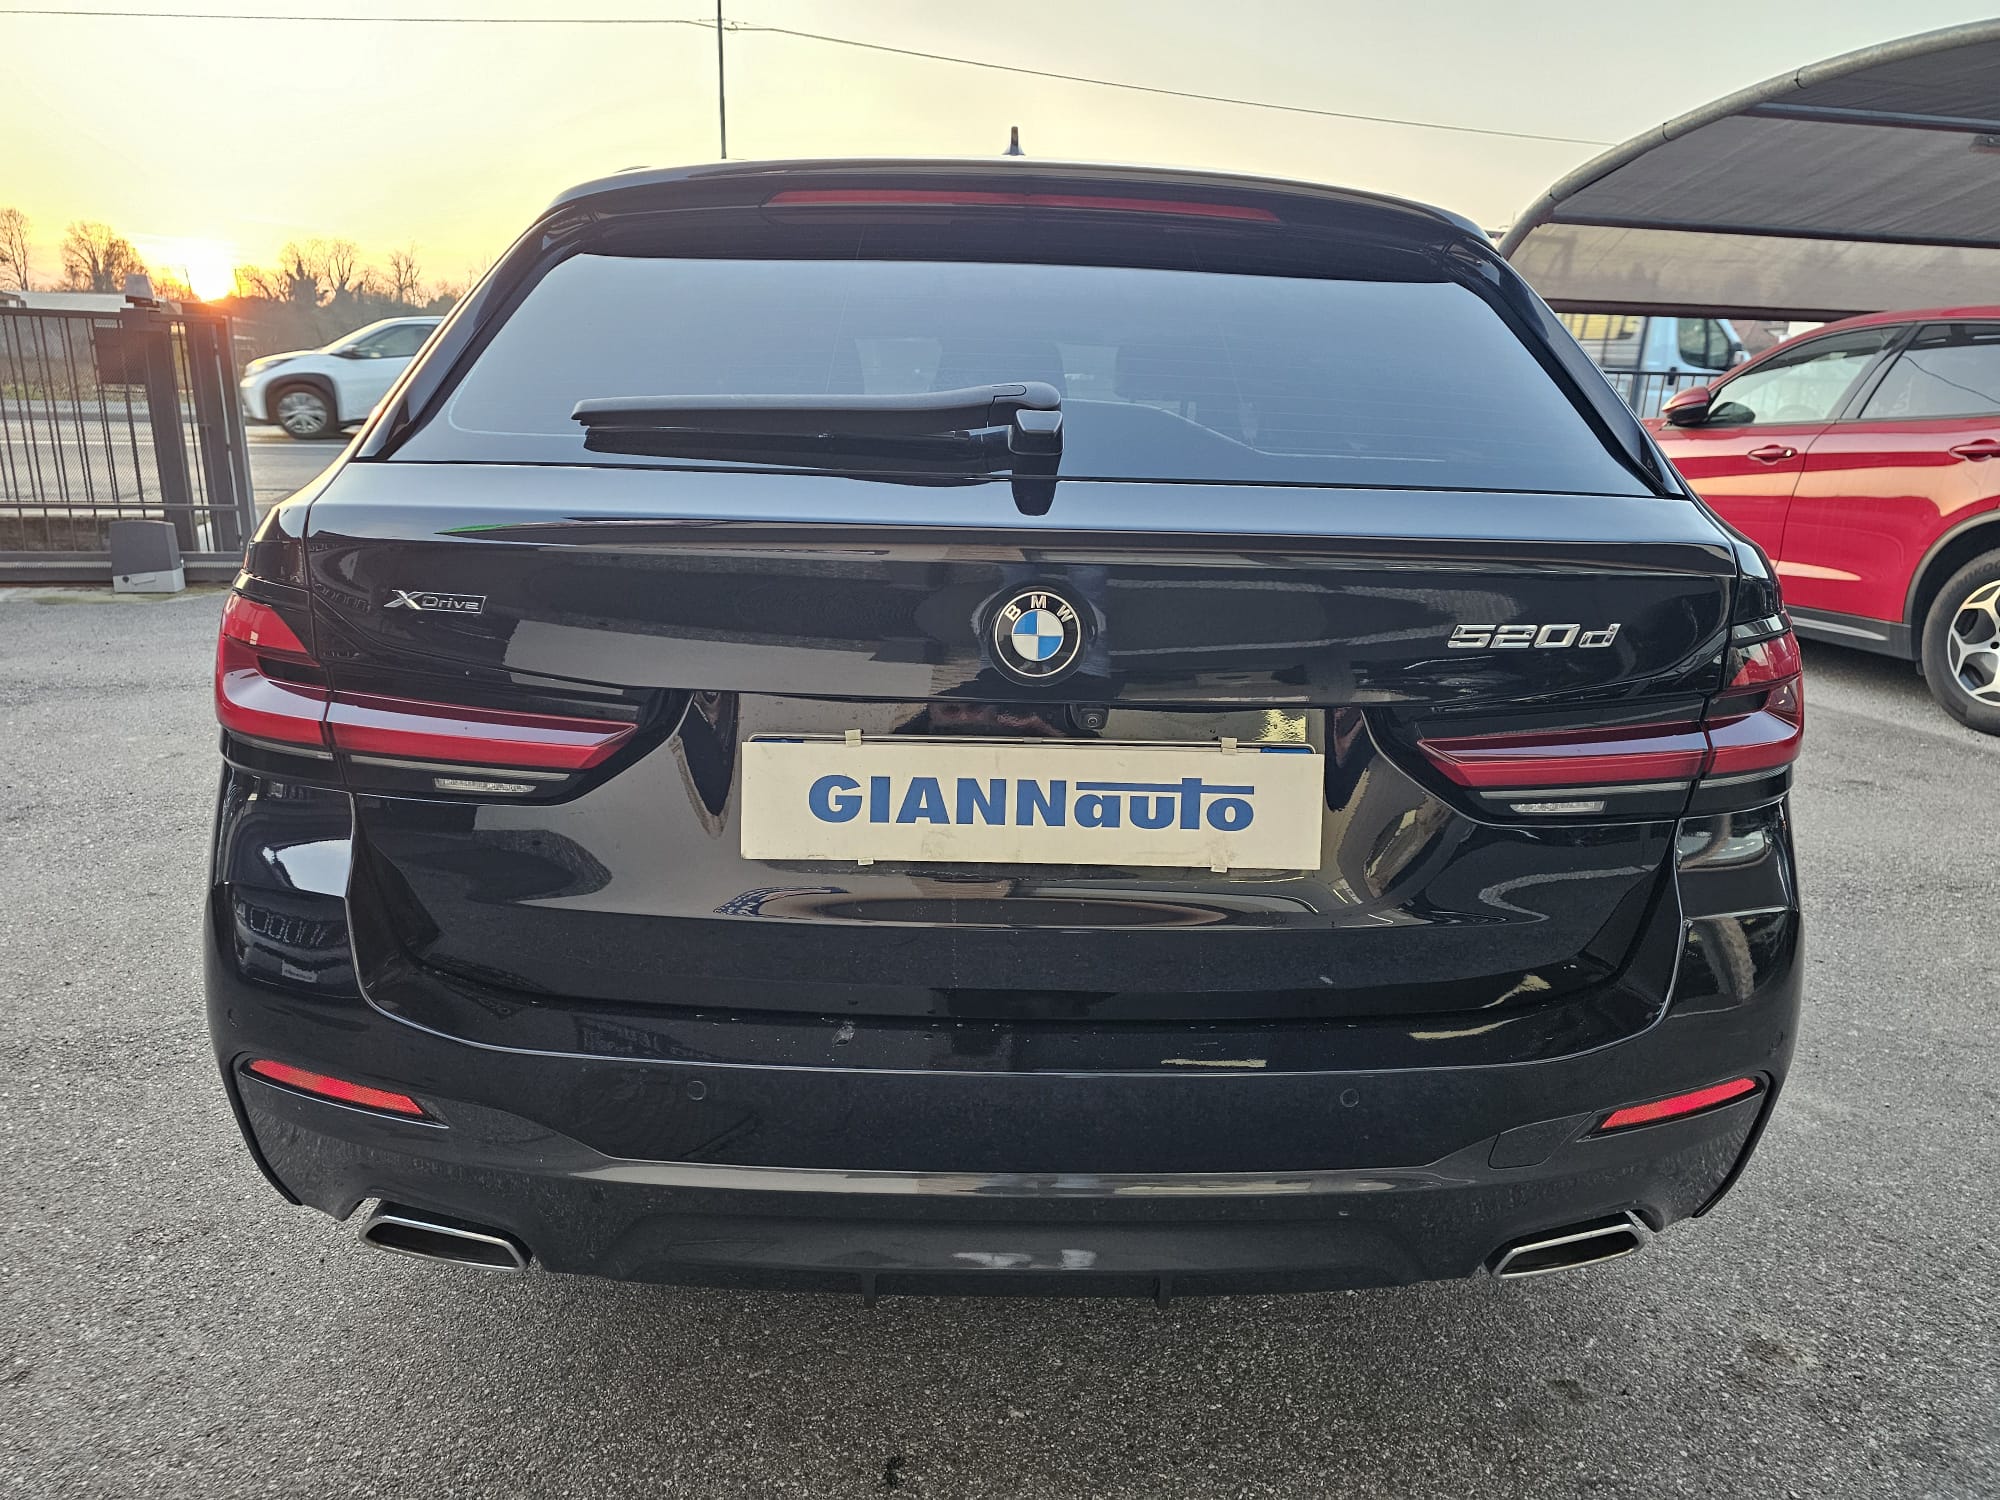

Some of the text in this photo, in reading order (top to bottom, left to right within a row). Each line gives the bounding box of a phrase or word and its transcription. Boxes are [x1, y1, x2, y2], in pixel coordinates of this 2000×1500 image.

[1004, 595, 1073, 623] BMW
[1447, 623, 1621, 648] 520d
[808, 775, 1254, 831] GIANNauto
